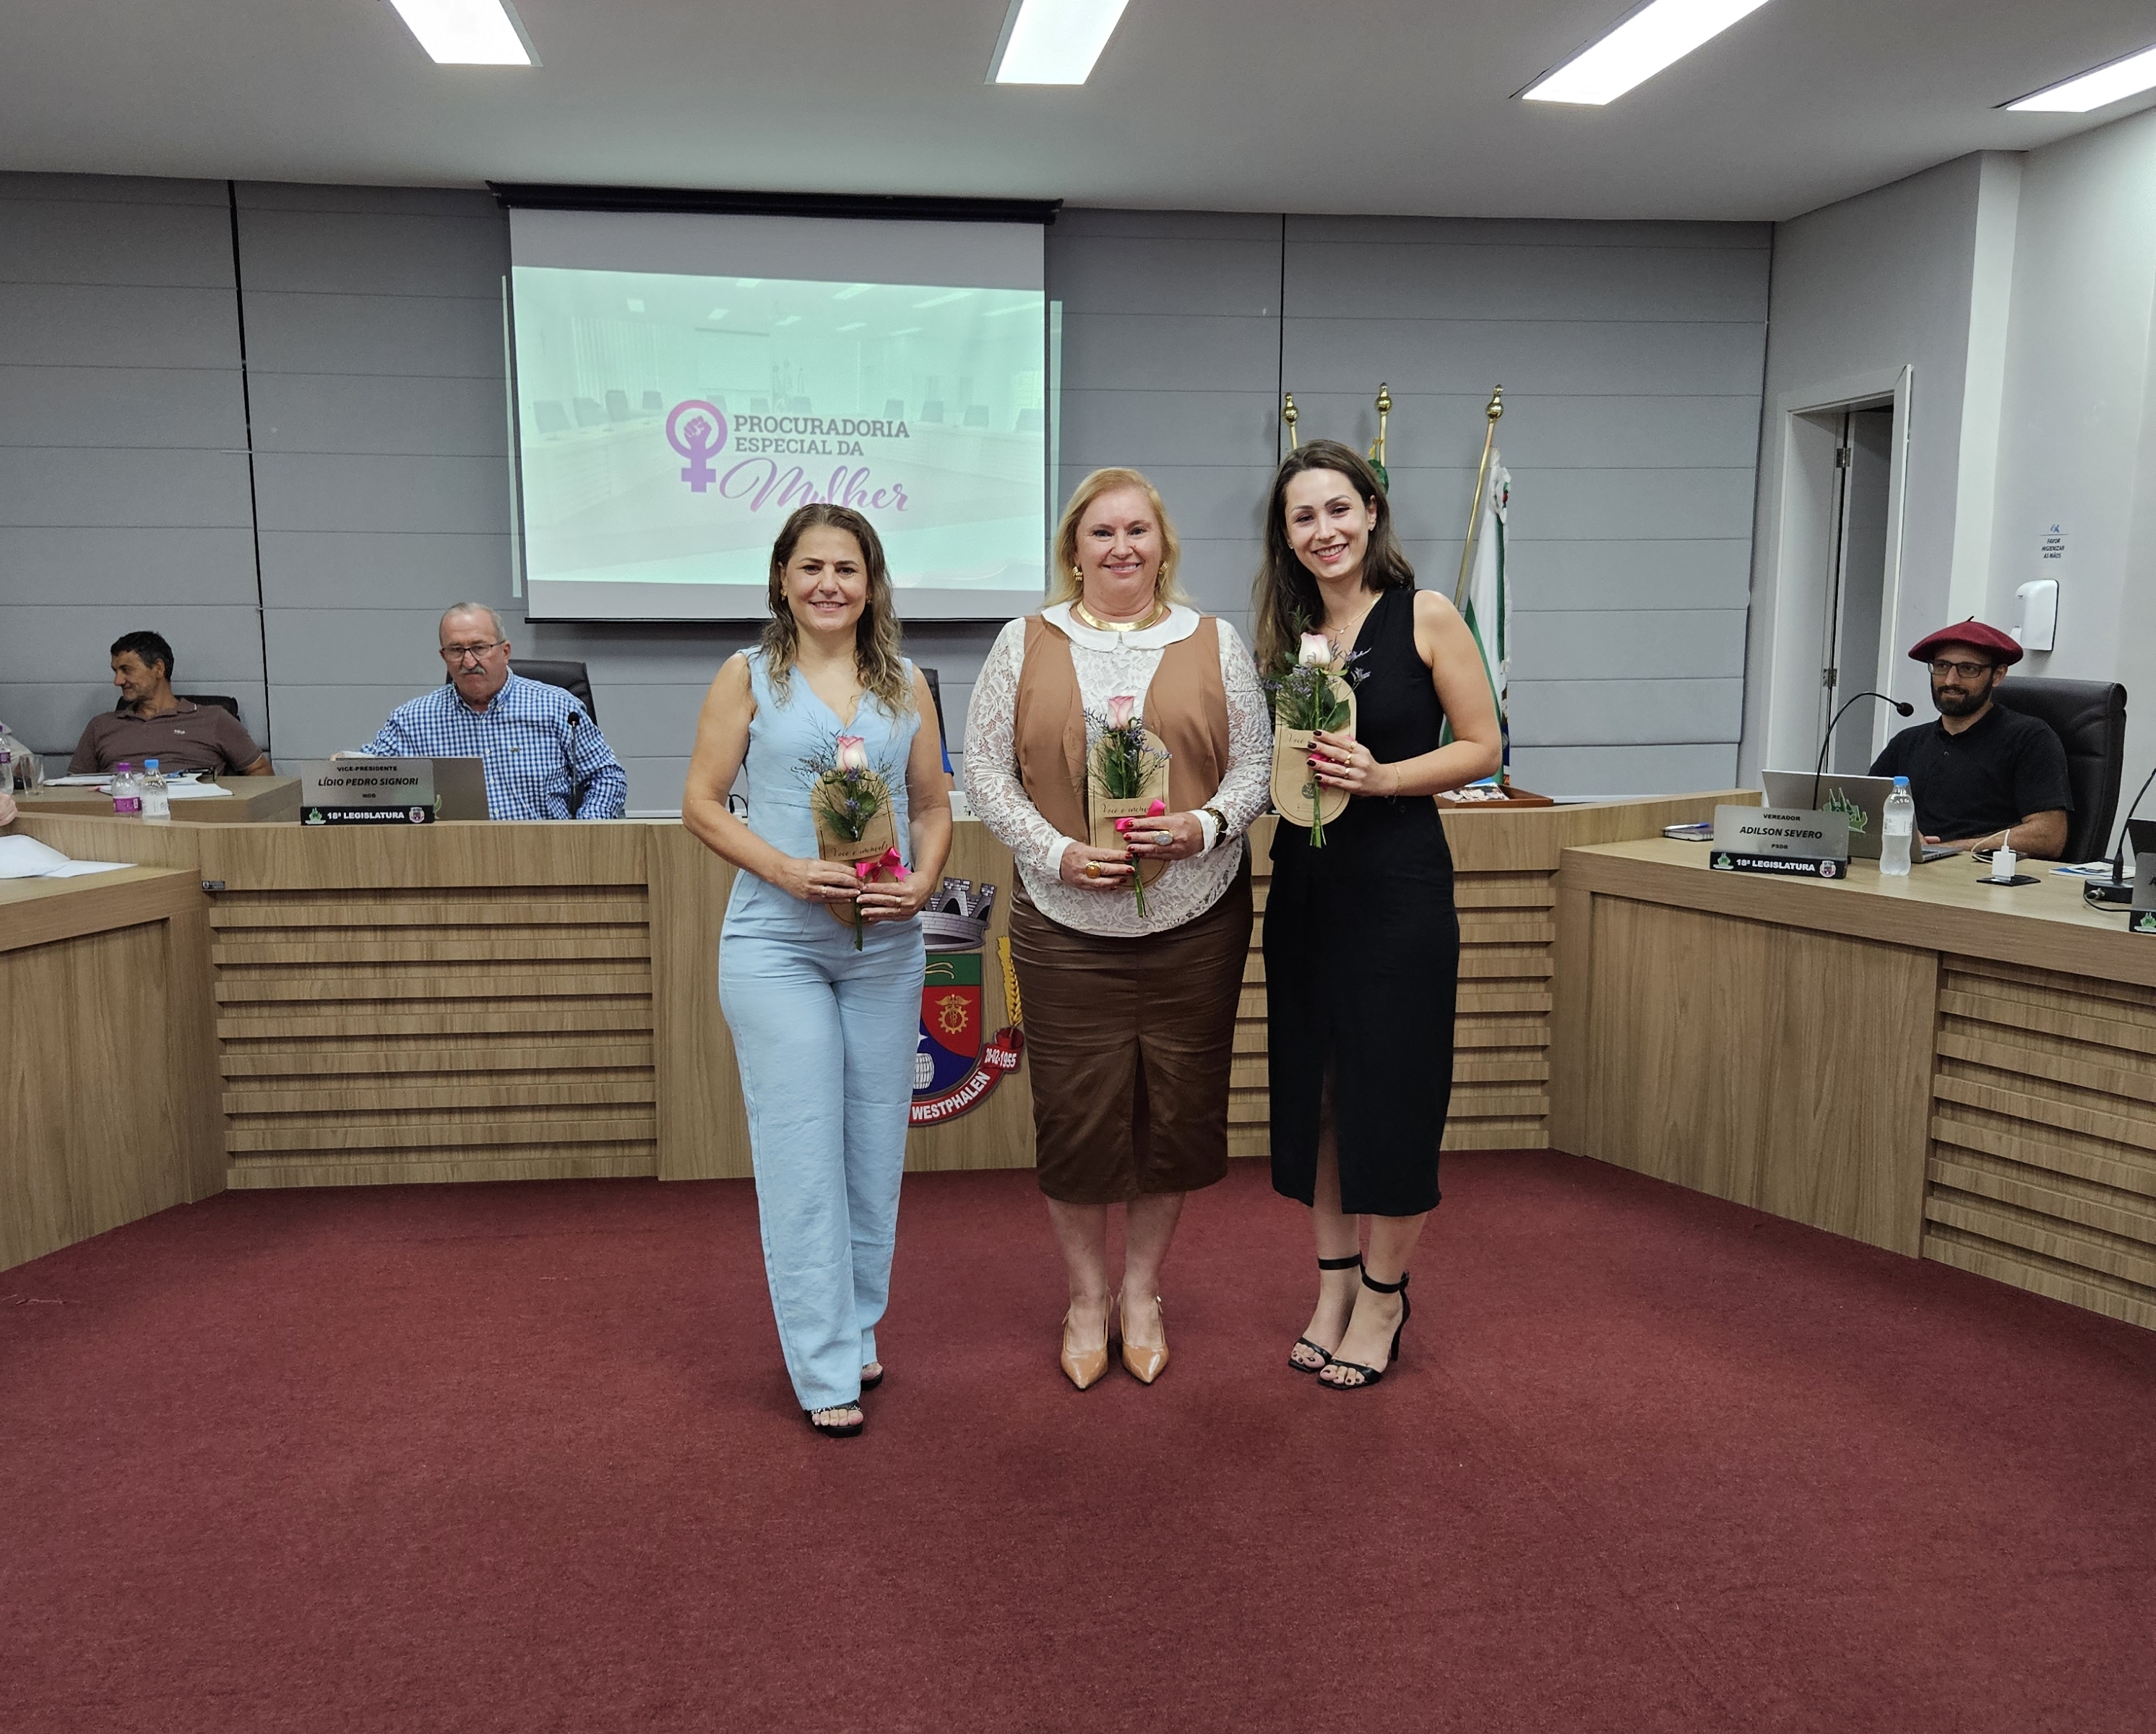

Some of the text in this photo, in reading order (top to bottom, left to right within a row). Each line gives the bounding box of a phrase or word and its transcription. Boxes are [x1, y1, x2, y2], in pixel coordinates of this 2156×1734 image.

[734, 415, 910, 438] PROCURADORIA
[735, 437, 864, 456] ESPECIAL DA
[319, 777, 343, 786] LÍDIO
[1740, 827, 1822, 839] ADILSON SEVERO
[1752, 860, 1816, 871] LEGISLATURA
[912, 1071, 991, 1120] WESTPHALEN
